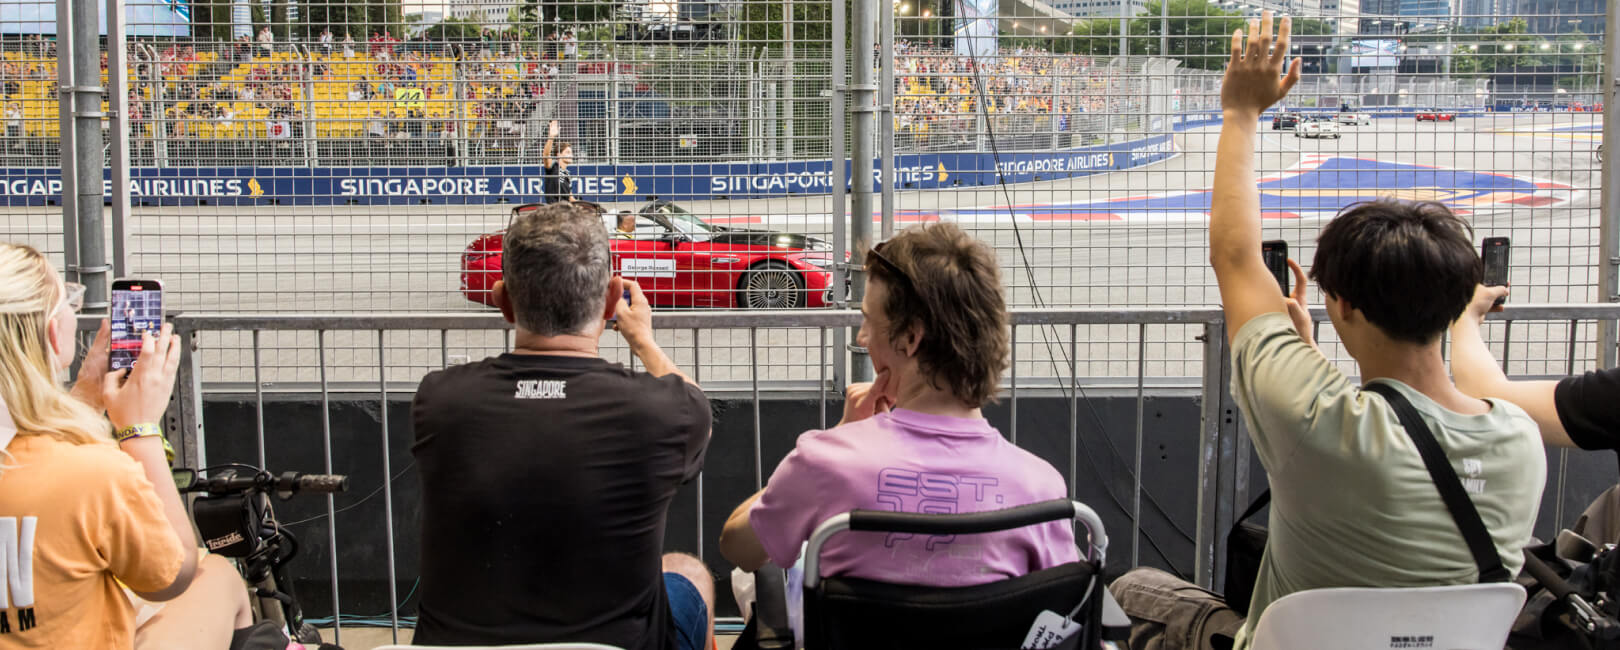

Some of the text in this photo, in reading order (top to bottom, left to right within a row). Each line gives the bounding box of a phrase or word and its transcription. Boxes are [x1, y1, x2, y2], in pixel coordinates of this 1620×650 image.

[995, 152, 1109, 177] SINGAPORE AIRLINES
[129, 179, 242, 197] AIRLINES
[340, 177, 616, 196] SINGAPORE AIRNES
[514, 380, 567, 399] SINGAPORE
[878, 467, 1004, 505] EST.
